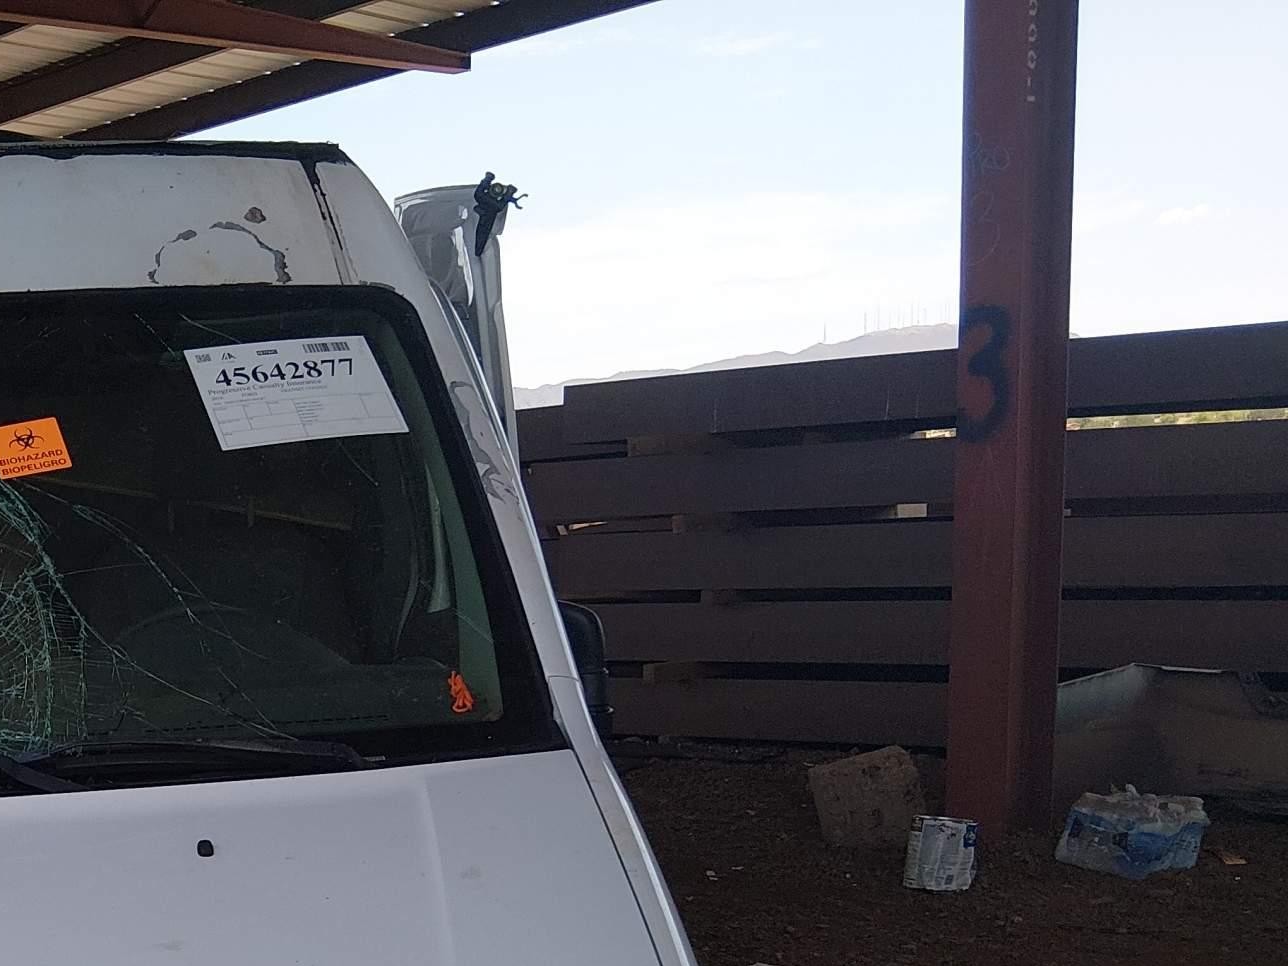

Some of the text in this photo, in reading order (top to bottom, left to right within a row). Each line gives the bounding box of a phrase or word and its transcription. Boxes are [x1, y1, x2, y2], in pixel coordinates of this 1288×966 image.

[215, 358, 353, 386] 45642877
[959, 305, 1009, 444] 3
[0, 449, 63, 466] BIOHAZARD
[1, 458, 67, 475] BIOPELIGRO
